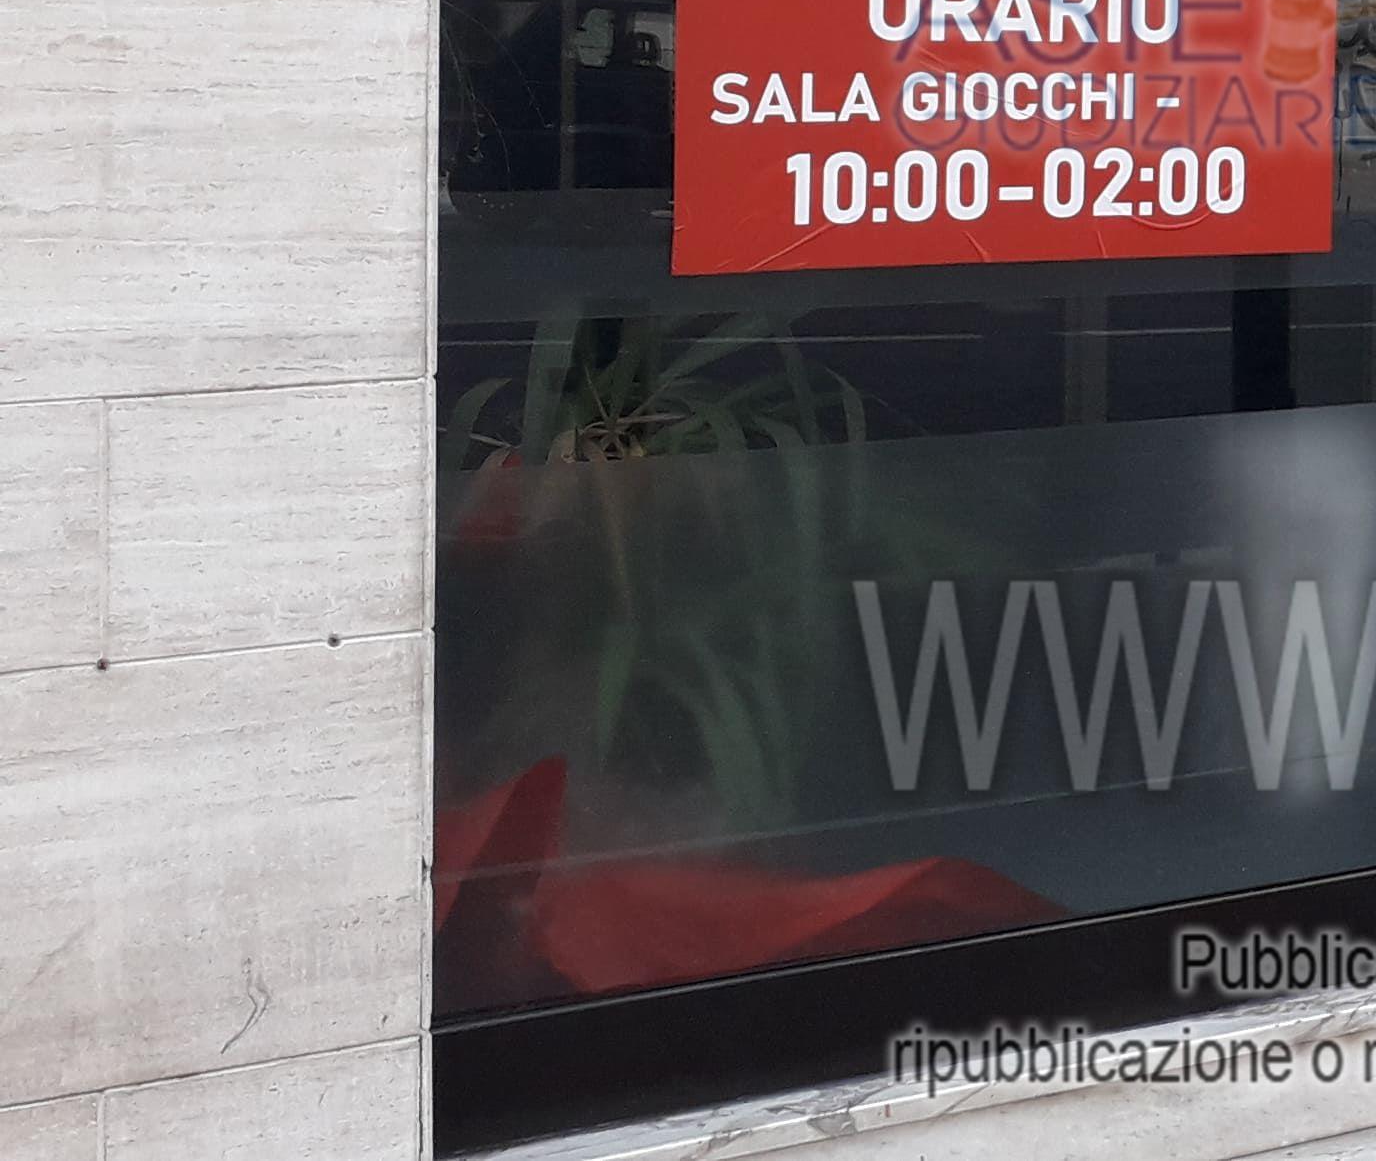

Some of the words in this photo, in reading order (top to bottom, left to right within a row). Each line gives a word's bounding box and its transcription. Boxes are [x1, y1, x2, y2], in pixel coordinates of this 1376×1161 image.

[710, 71, 881, 126] SALA
[901, 70, 1136, 121] GIOCCHI
[786, 145, 1246, 227] 10:00-02:00
